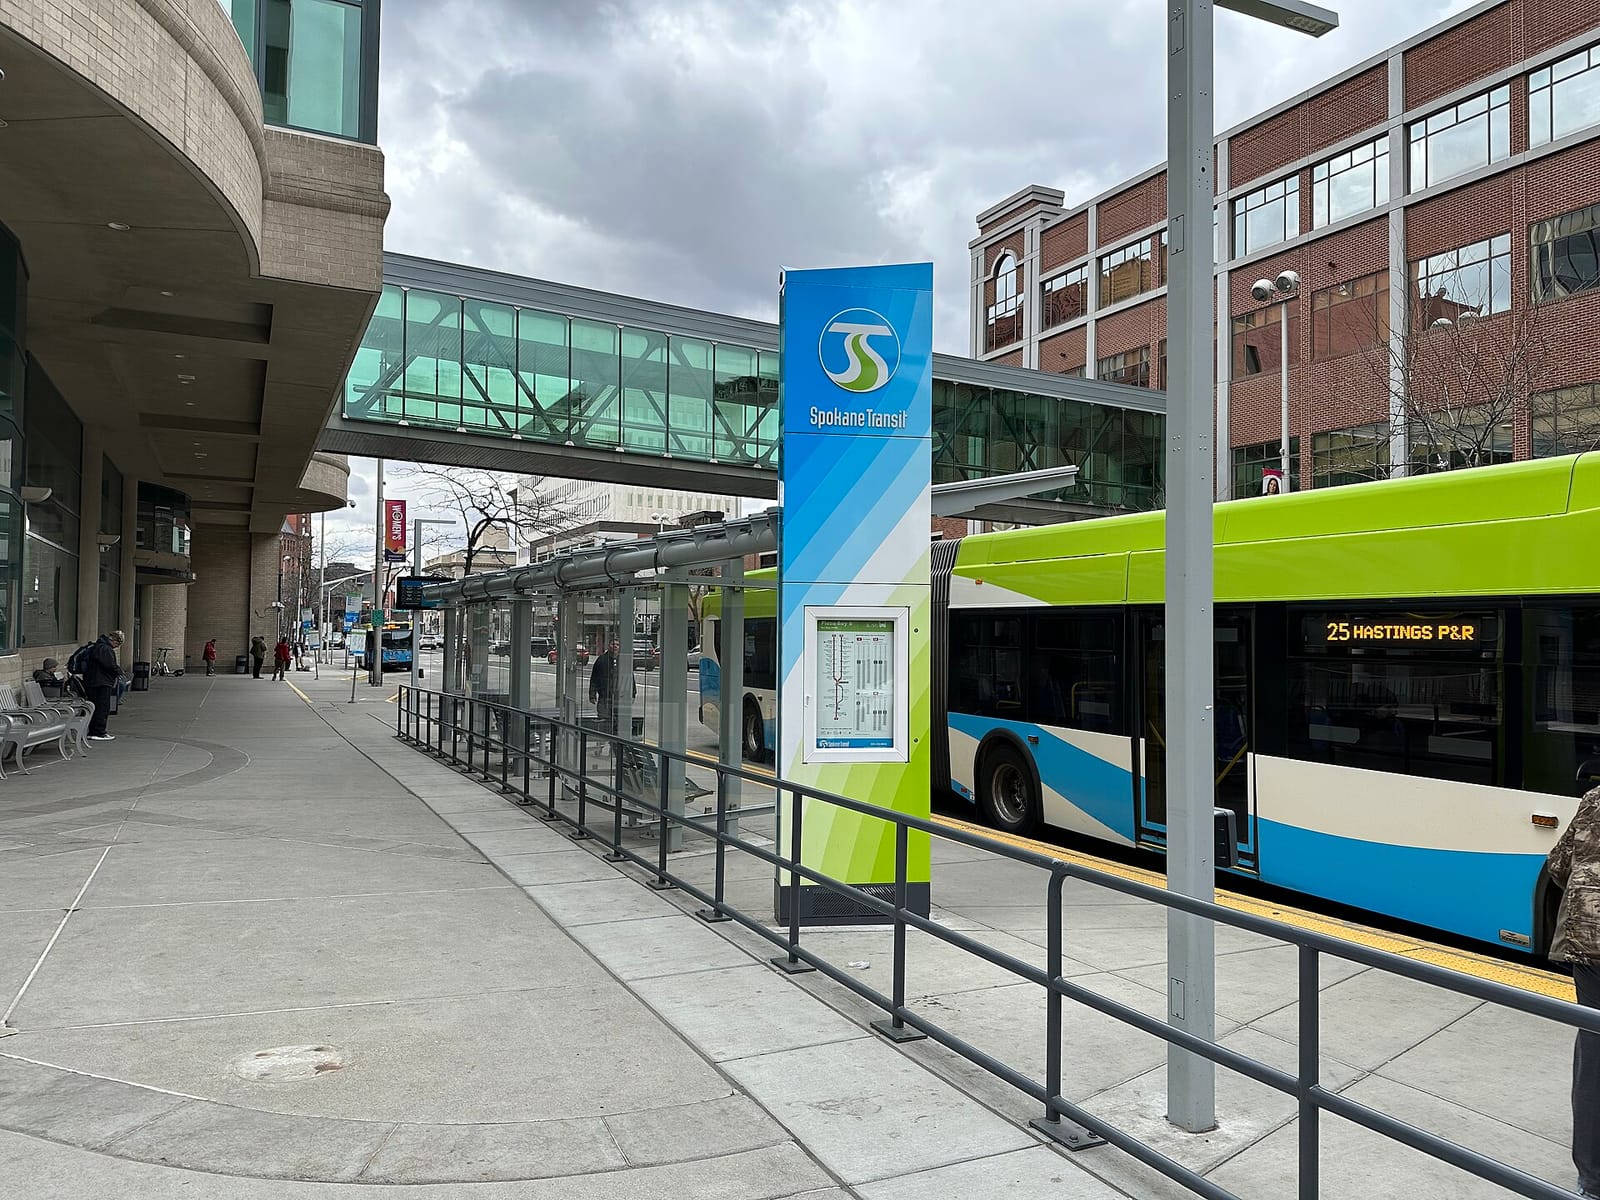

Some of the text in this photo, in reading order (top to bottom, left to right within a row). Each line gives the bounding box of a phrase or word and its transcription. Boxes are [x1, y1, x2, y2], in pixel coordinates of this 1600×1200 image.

[810, 406, 908, 429] Spokane Transit
[1327, 622, 1474, 641] 25 HASTINGS P&R
